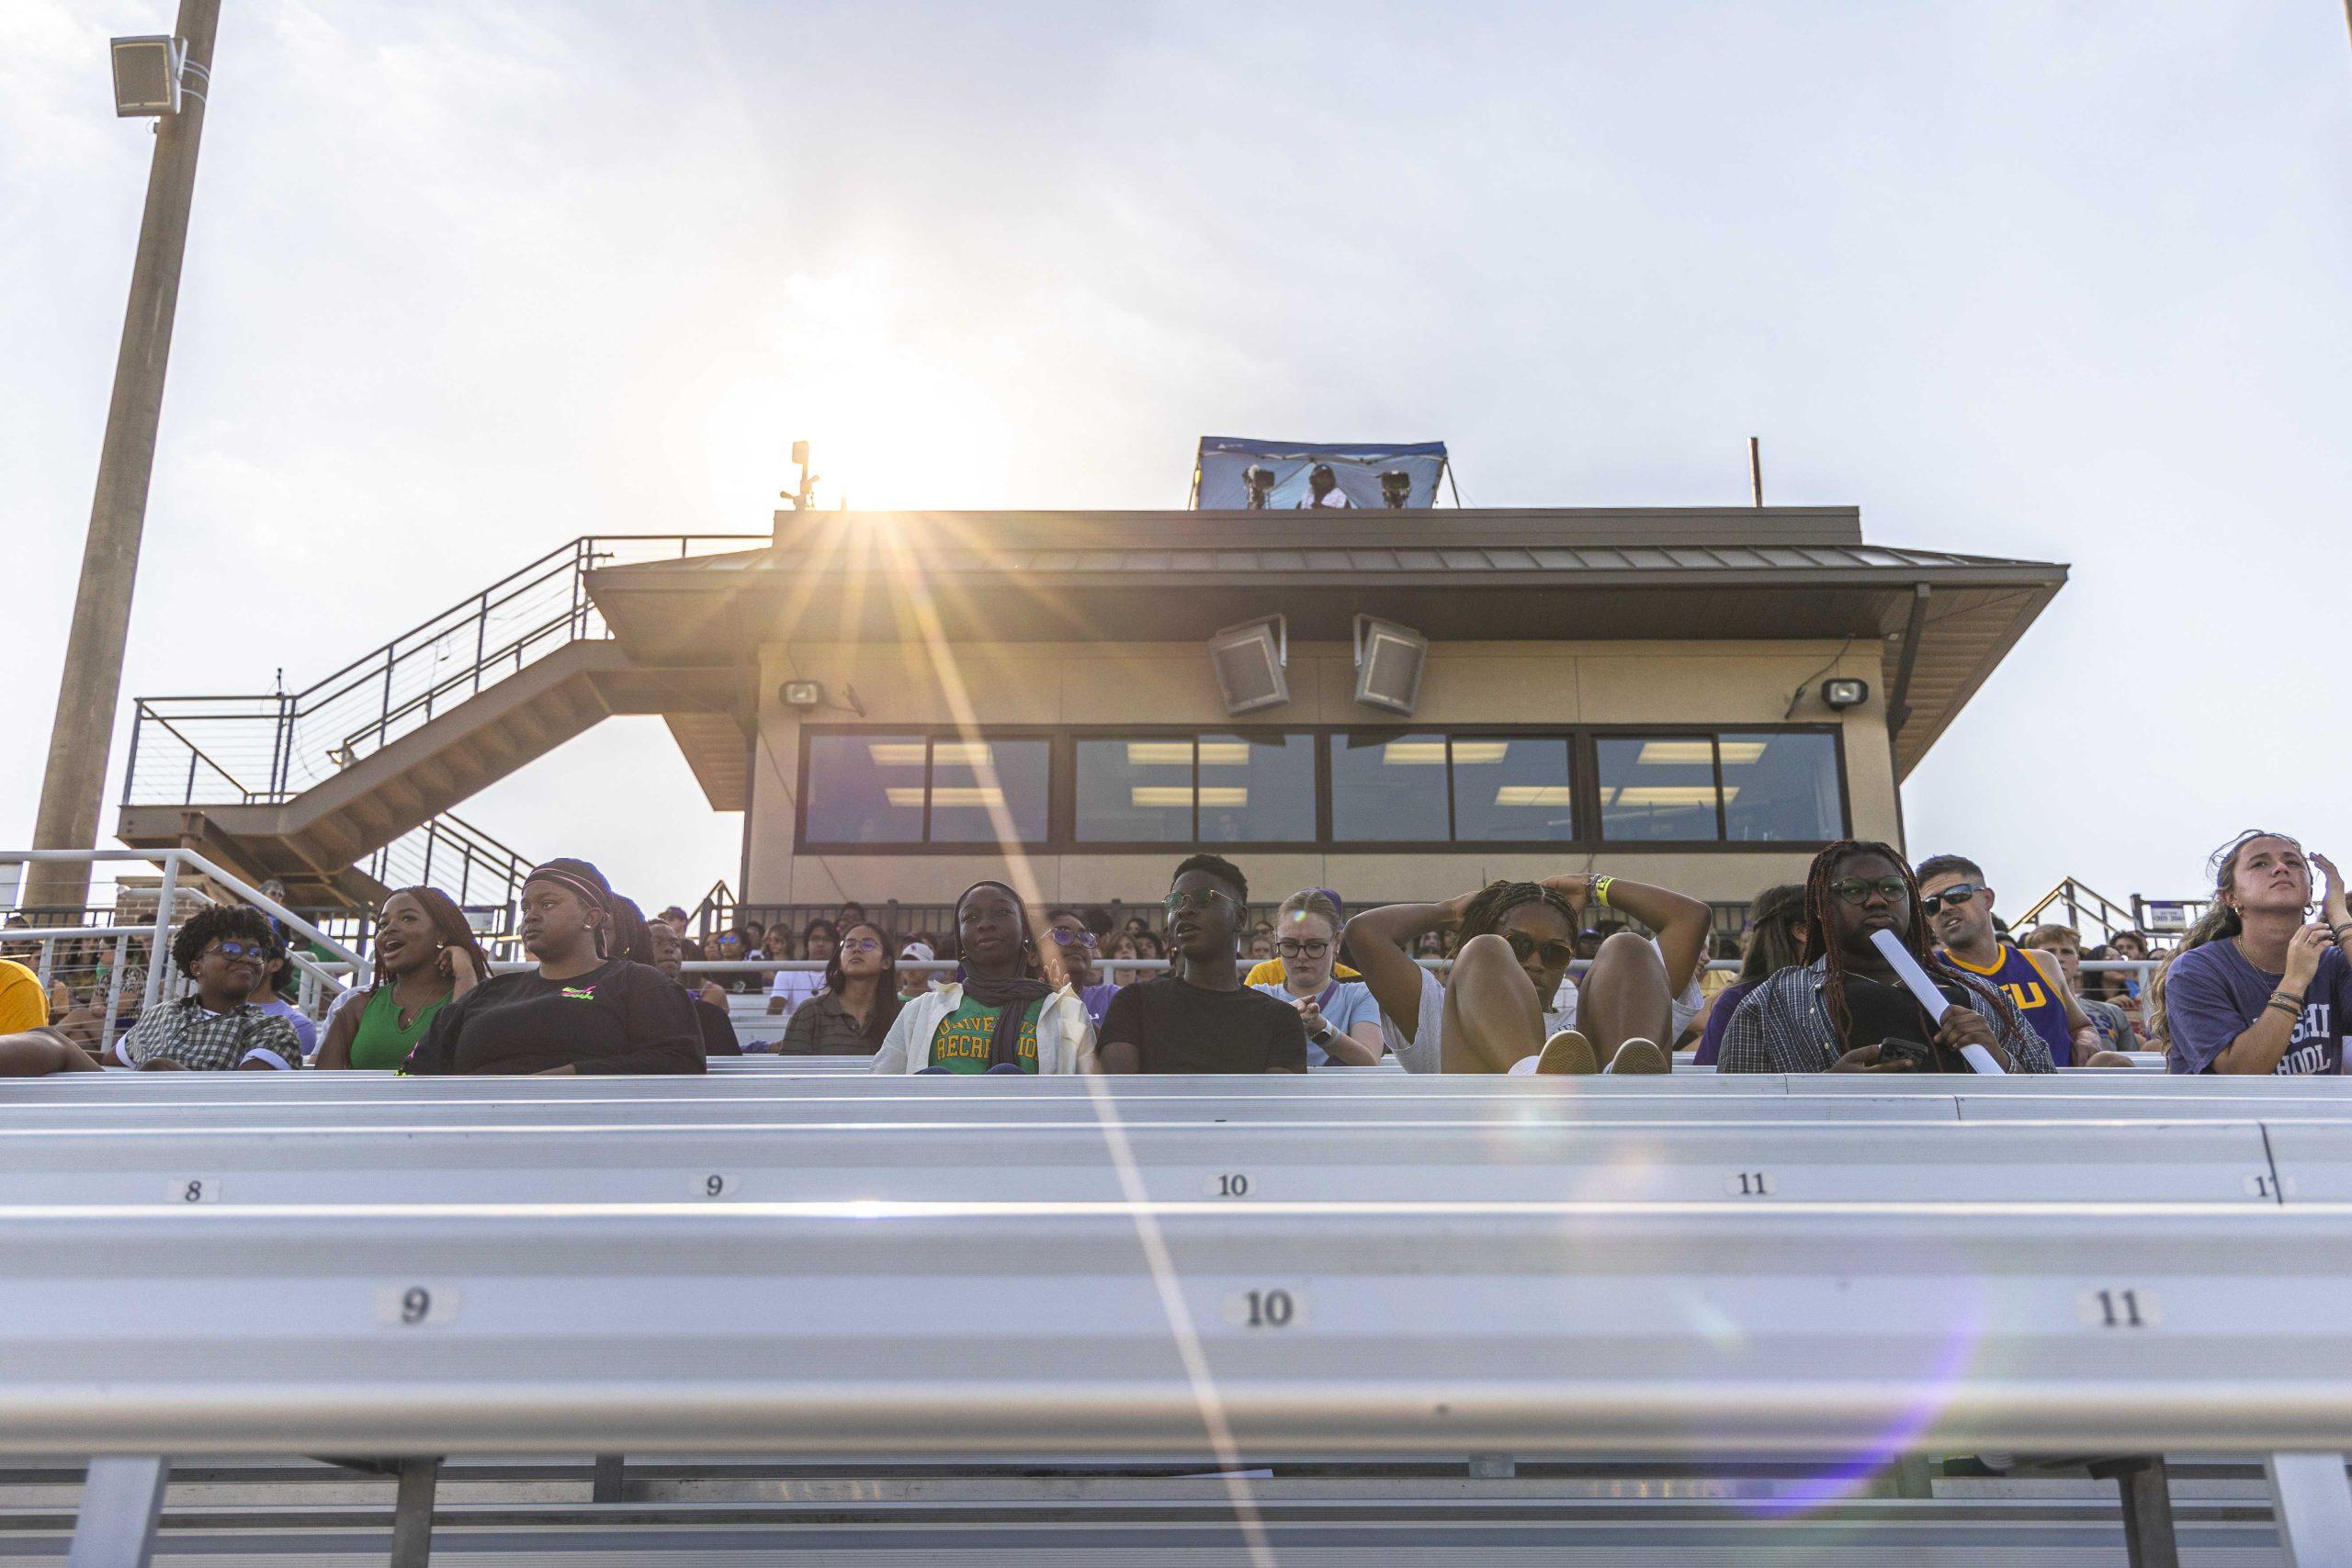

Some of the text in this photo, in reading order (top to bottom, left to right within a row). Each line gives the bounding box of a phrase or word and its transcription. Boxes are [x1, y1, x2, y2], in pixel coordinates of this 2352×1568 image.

[185, 1181, 201, 1201] 8
[707, 1176, 723, 1197] 9
[1219, 1175, 1248, 1196] 10
[1739, 1173, 1766, 1195] 11
[401, 1288, 430, 1324] 9
[1248, 1291, 1293, 1327] 10
[2098, 1291, 2143, 1327] 11
